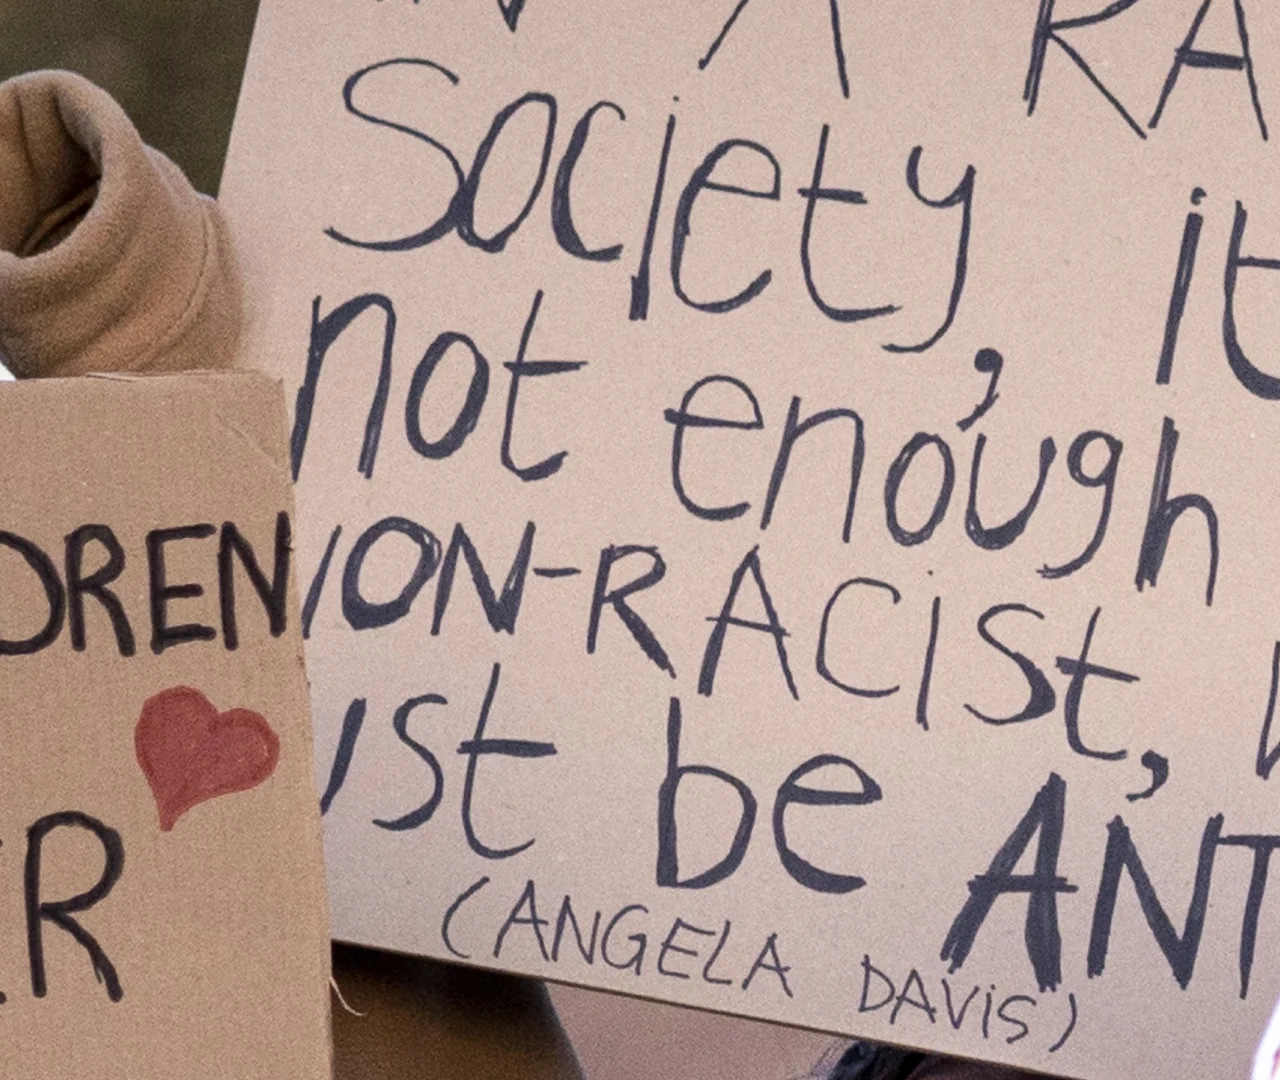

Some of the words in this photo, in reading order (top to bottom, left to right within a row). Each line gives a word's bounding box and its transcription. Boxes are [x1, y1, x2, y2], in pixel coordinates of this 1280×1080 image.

[292, 289, 588, 483] not
[663, 374, 1220, 605] enough
[655, 696, 884, 895] be
[441, 877, 794, 999] (ANGELA
